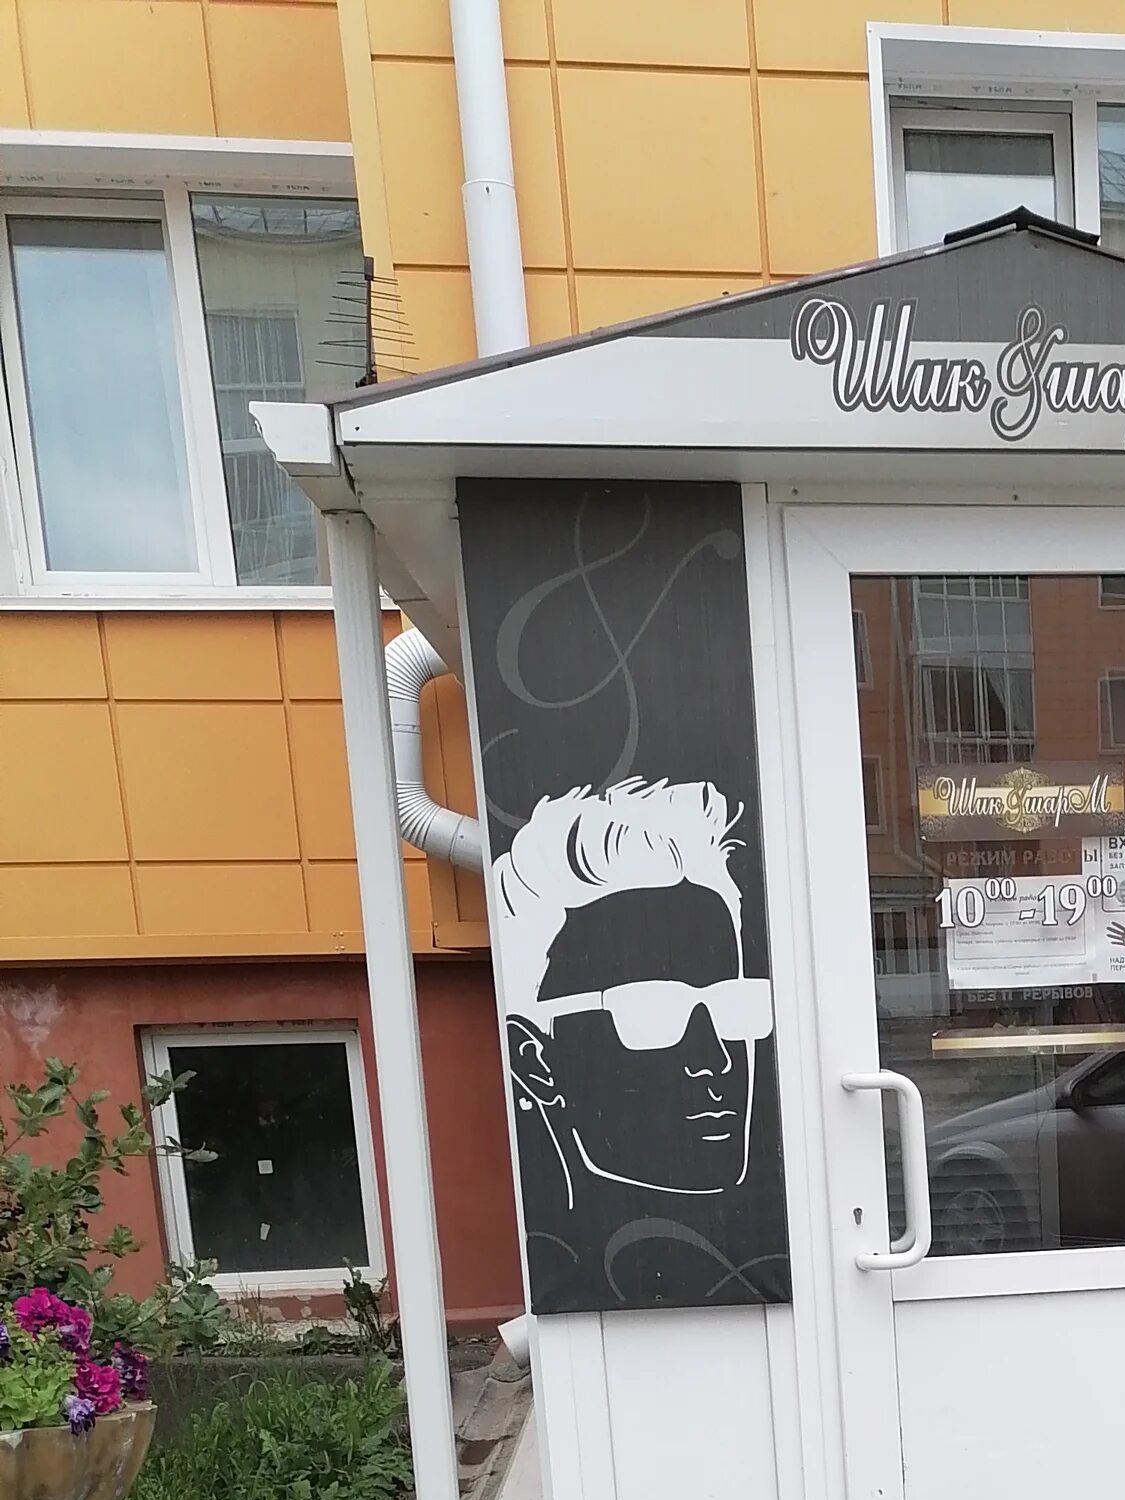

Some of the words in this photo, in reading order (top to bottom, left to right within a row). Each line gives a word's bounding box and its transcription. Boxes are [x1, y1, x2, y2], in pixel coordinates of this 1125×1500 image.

[791, 294, 990, 413] Шик
[933, 776, 1003, 816] Шик
[946, 850, 1016, 866] РЕЖИМ
[1108, 852, 1123, 860] БЕЗ
[967, 990, 996, 1002] БЕЗ
